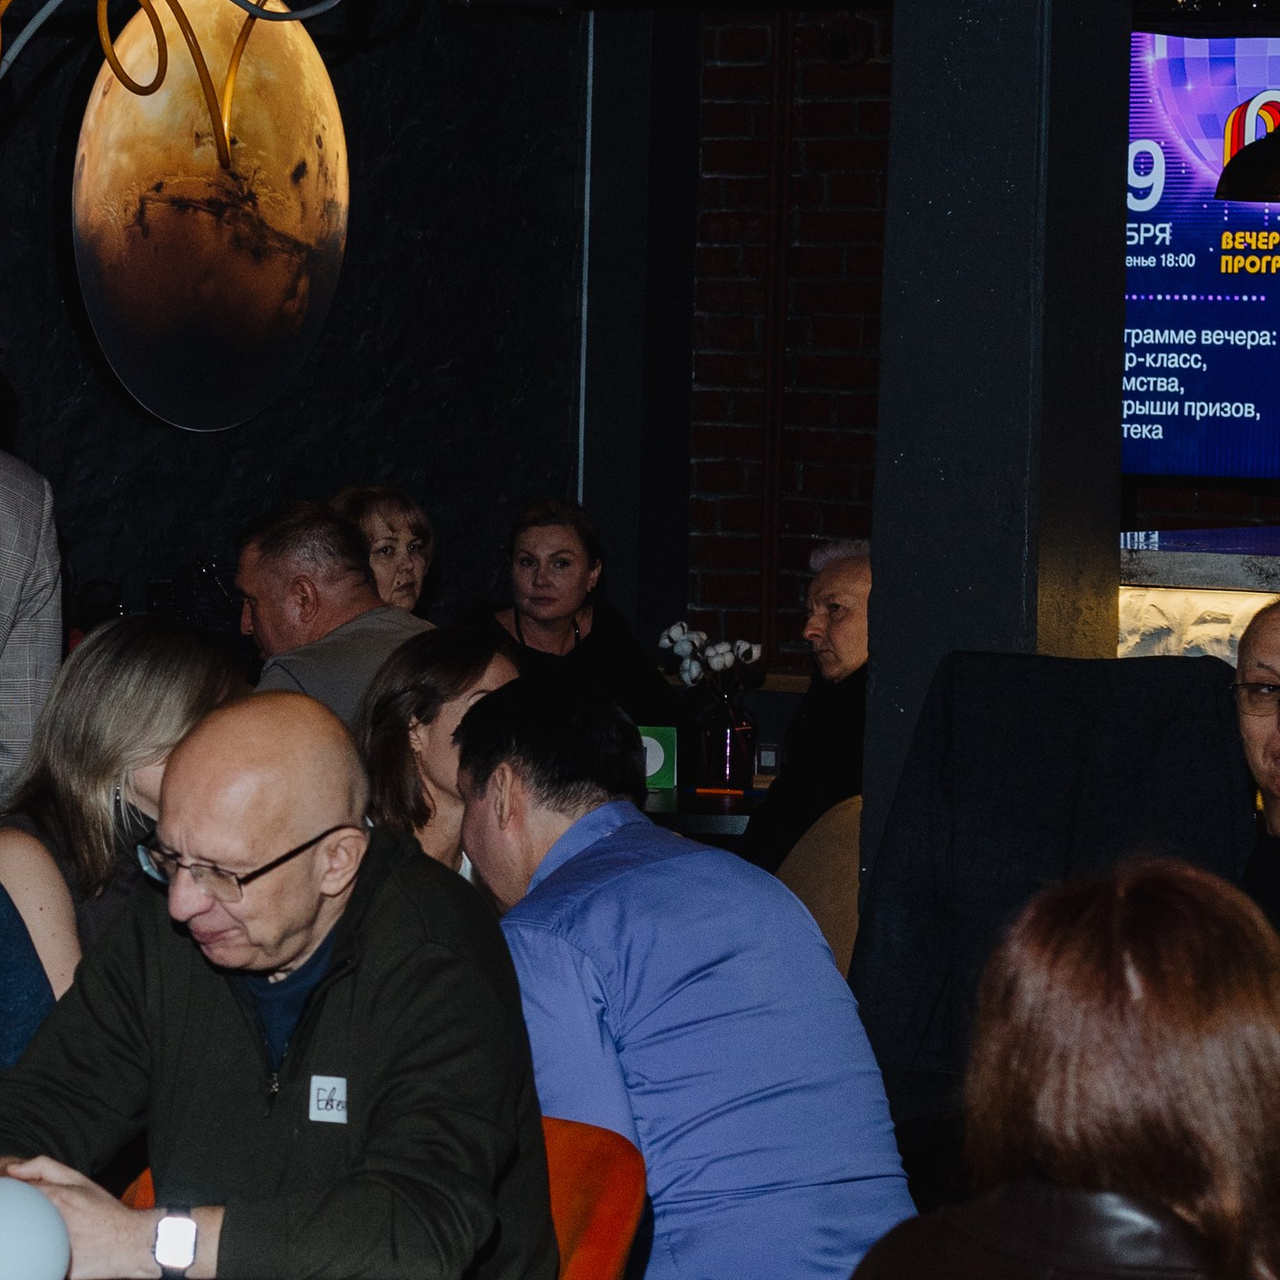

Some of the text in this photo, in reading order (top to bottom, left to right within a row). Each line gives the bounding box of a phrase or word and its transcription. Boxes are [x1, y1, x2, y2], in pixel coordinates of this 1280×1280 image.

[1126, 138, 1166, 212] 9
[1125, 253, 1196, 268] енье 18:00
[1124, 328, 1277, 350] грамме вечера:
[1124, 352, 1207, 372] р-класс,
[1122, 376, 1185, 395] мства,
[1184, 401, 1261, 421] призов,
[1121, 423, 1164, 440] тека
